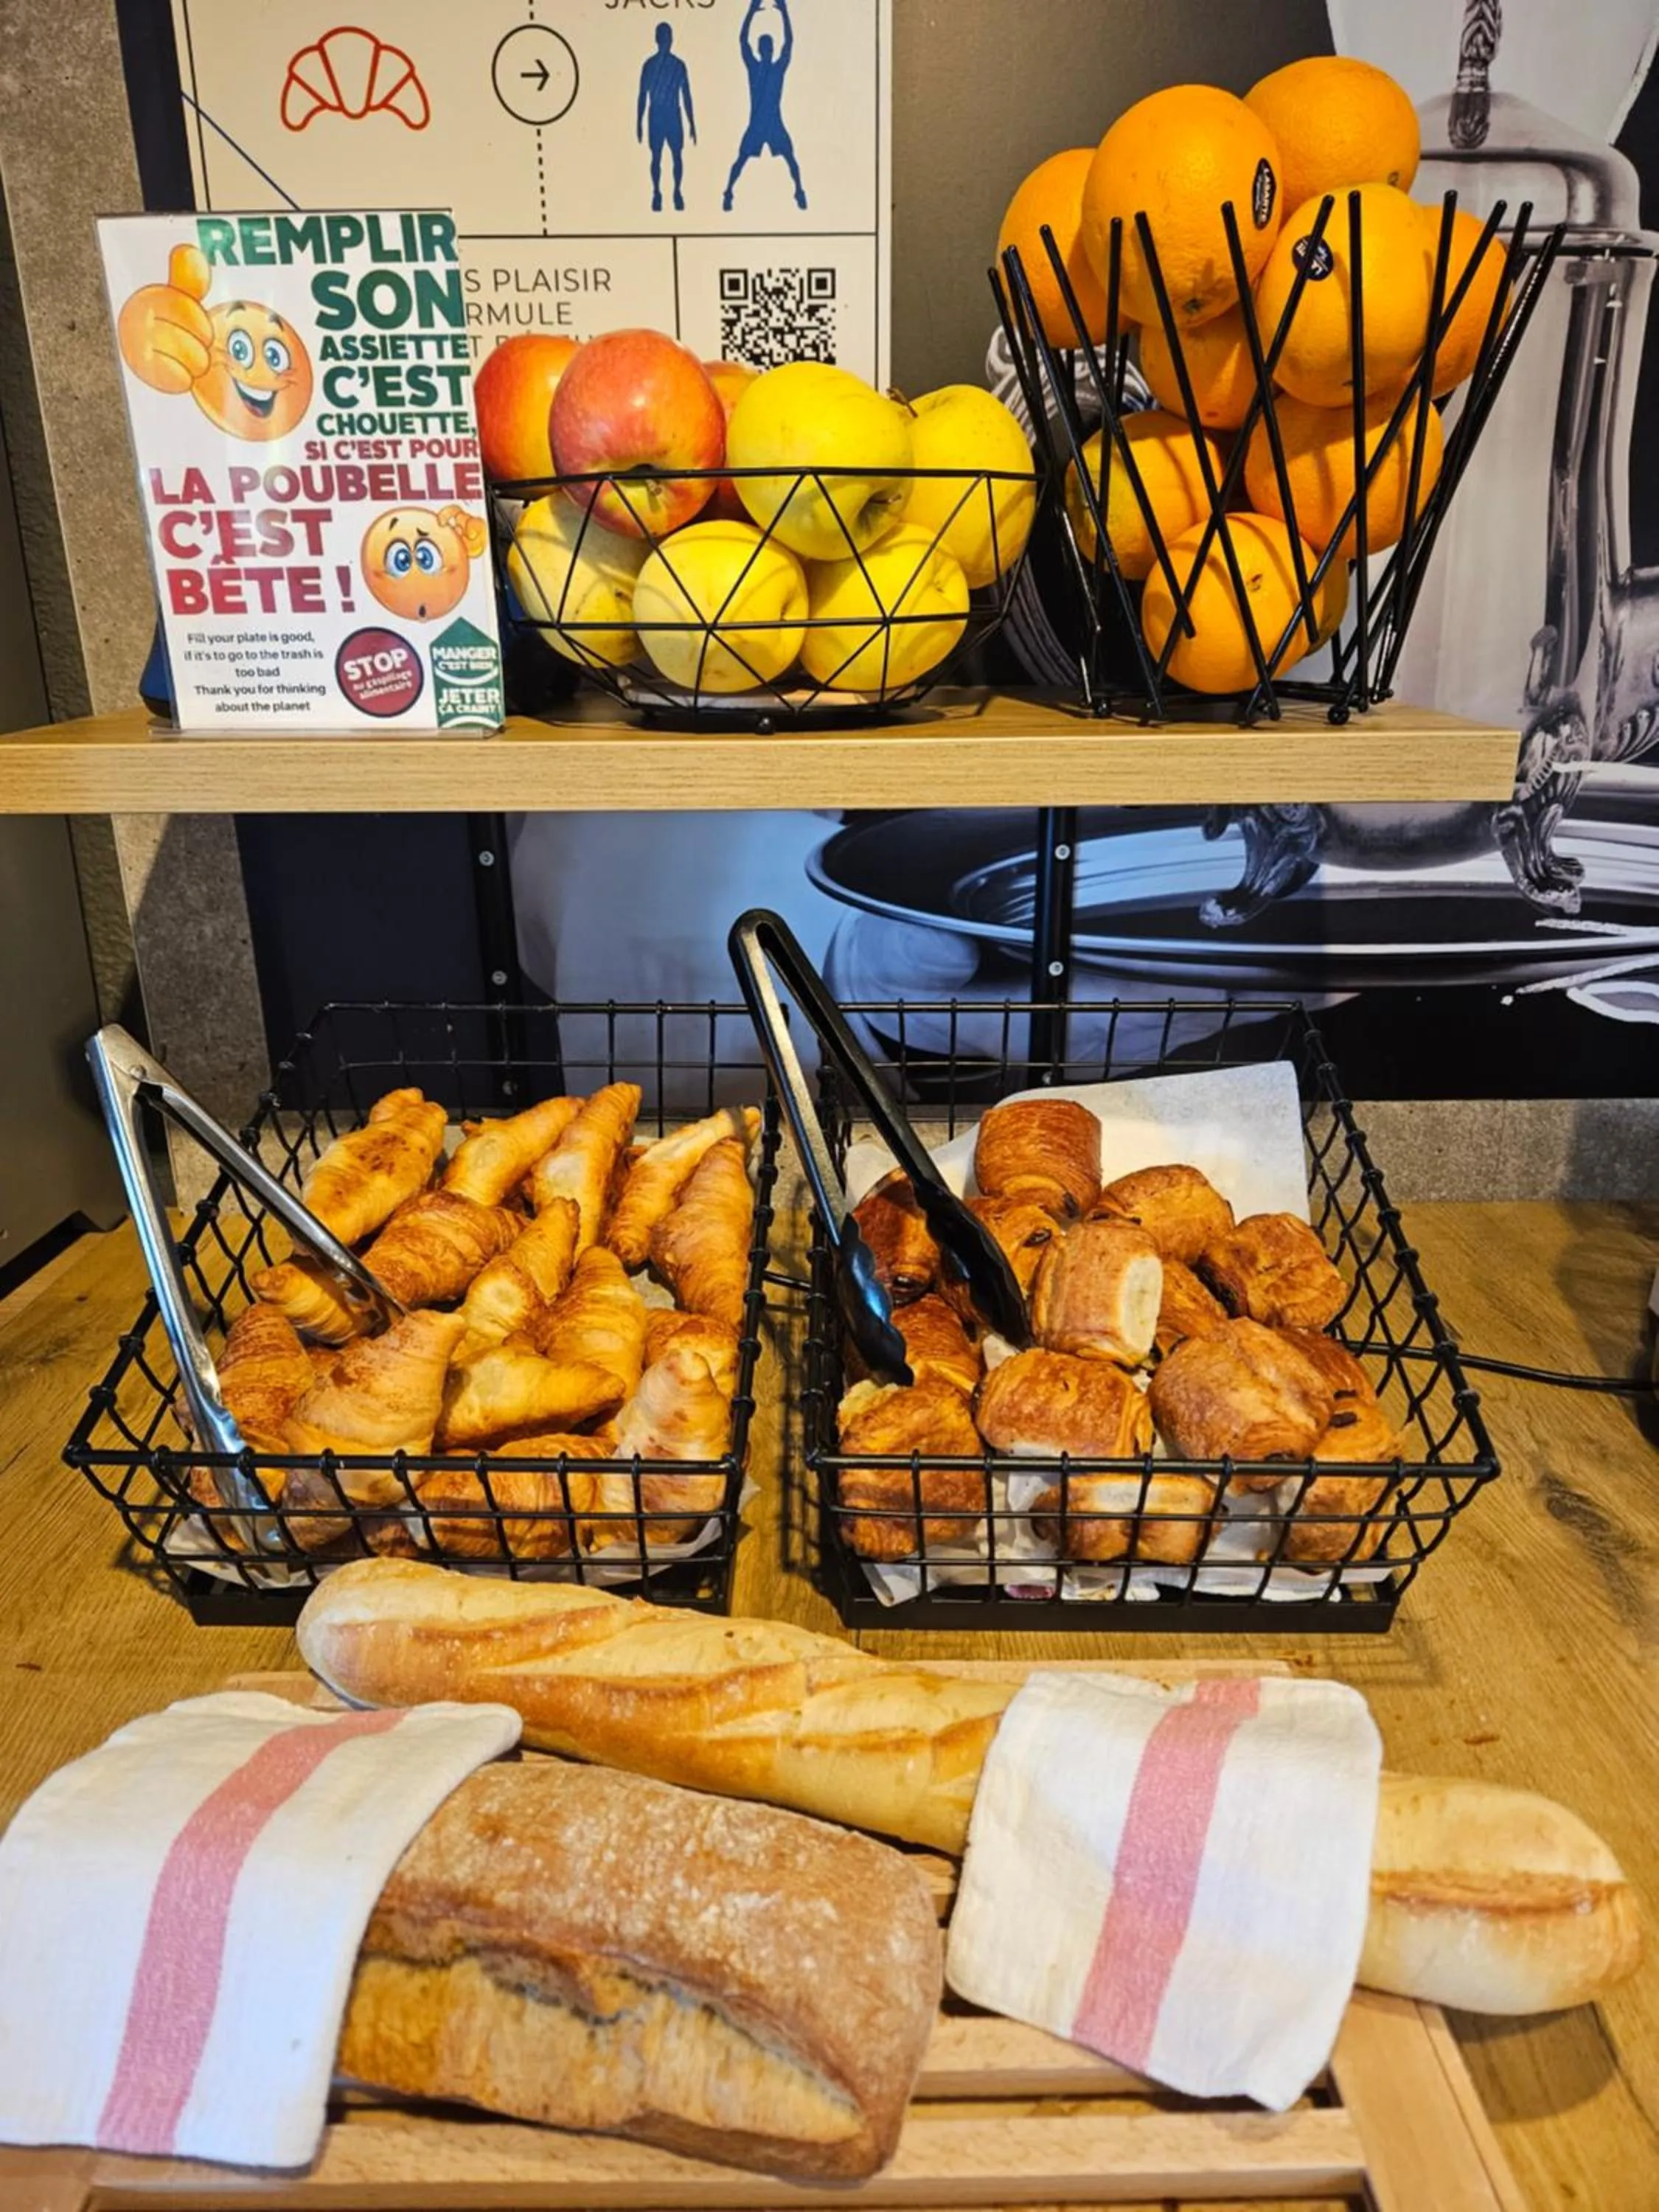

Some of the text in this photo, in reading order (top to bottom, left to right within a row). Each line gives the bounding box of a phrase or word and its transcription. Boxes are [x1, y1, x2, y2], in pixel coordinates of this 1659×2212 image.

[196, 213, 459, 266] REMPLIR
[493, 267, 612, 293] PLAISIR
[311, 269, 466, 330] SON
[465, 301, 573, 326] RMULE
[319, 334, 470, 361] ASSIETTE
[322, 364, 471, 408] C'EST
[316, 411, 477, 438] CHOUETTE,
[305, 438, 479, 460] SI C'EST POUR
[148, 462, 484, 504] LA POUBELLE
[158, 508, 333, 559] C'EST
[166, 554, 327, 615] BÊTE
[187, 631, 315, 645] Fill your plate is good,
[184, 648, 324, 662] if it's to go to the trash is
[344, 647, 408, 681] STOP
[433, 647, 497, 661] MANGER
[235, 667, 280, 678] too bad
[195, 684, 326, 696] Thank you for thinking
[439, 688, 500, 703] JETER
[215, 701, 310, 713] about the planet
